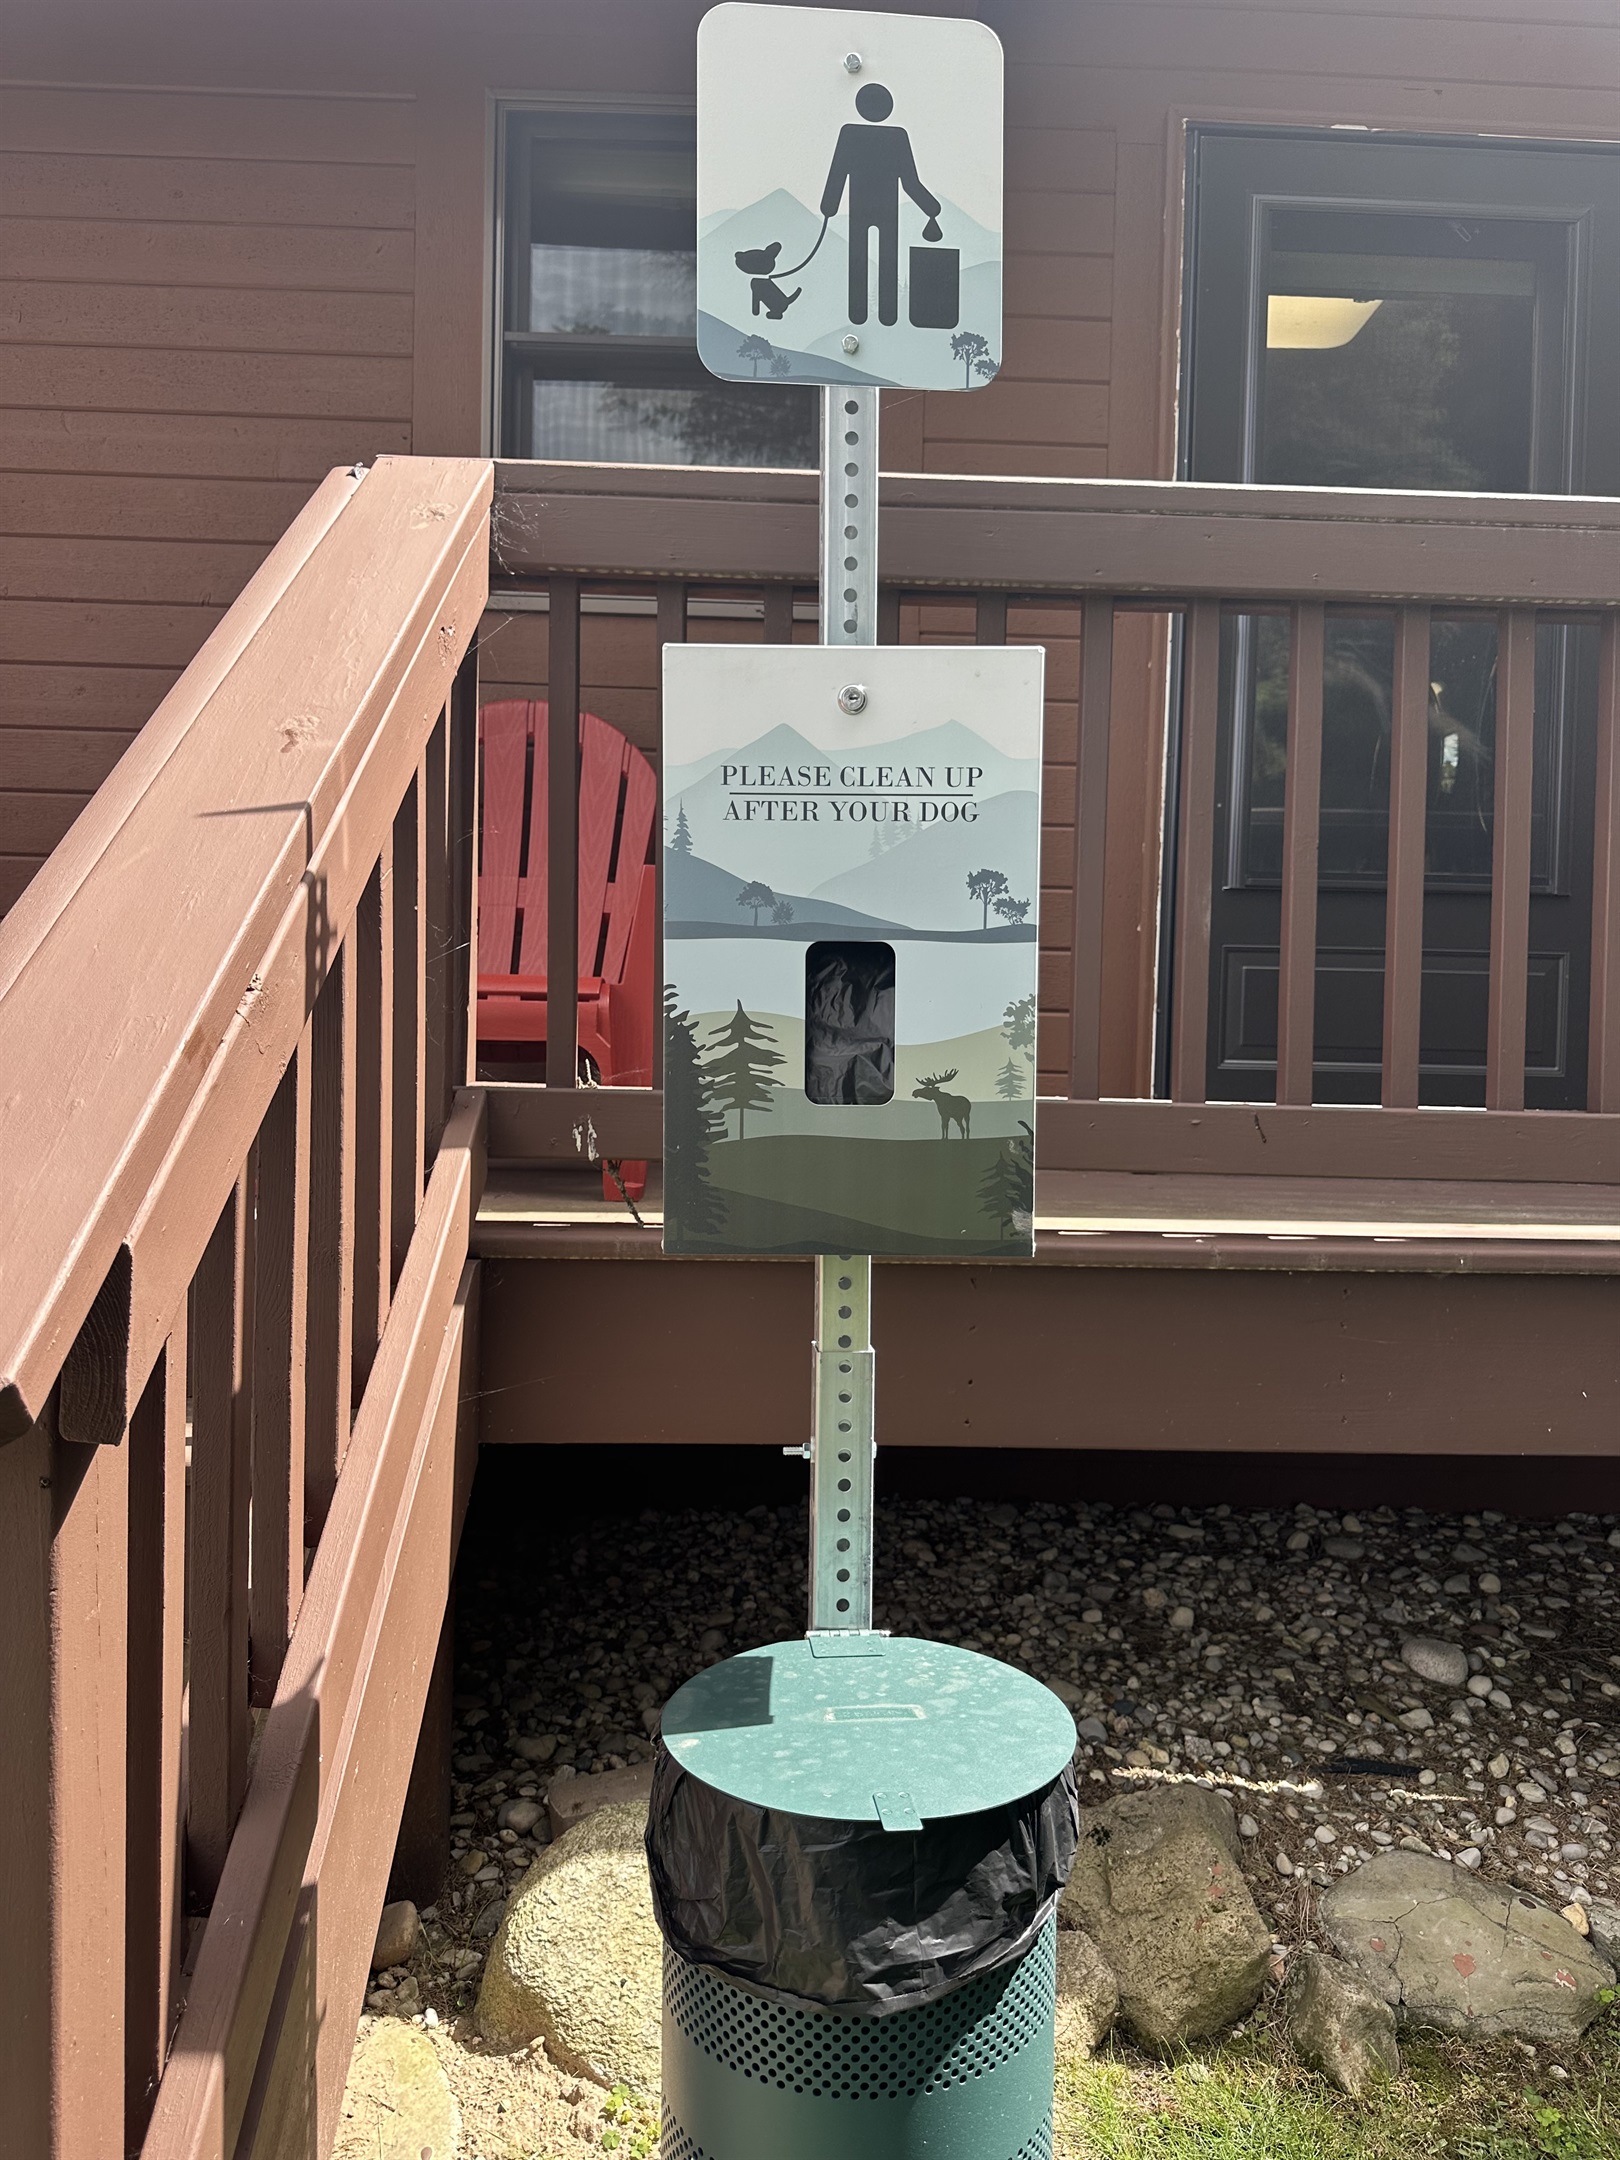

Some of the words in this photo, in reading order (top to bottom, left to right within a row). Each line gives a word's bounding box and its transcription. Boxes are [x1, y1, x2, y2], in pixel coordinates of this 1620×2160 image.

[720, 765, 831, 787] PLEASE
[839, 766, 936, 788] CLEAN
[944, 767, 983, 788] UP
[723, 800, 819, 822] AFTER
[829, 800, 911, 822] YOUR
[918, 801, 980, 823] DOG
